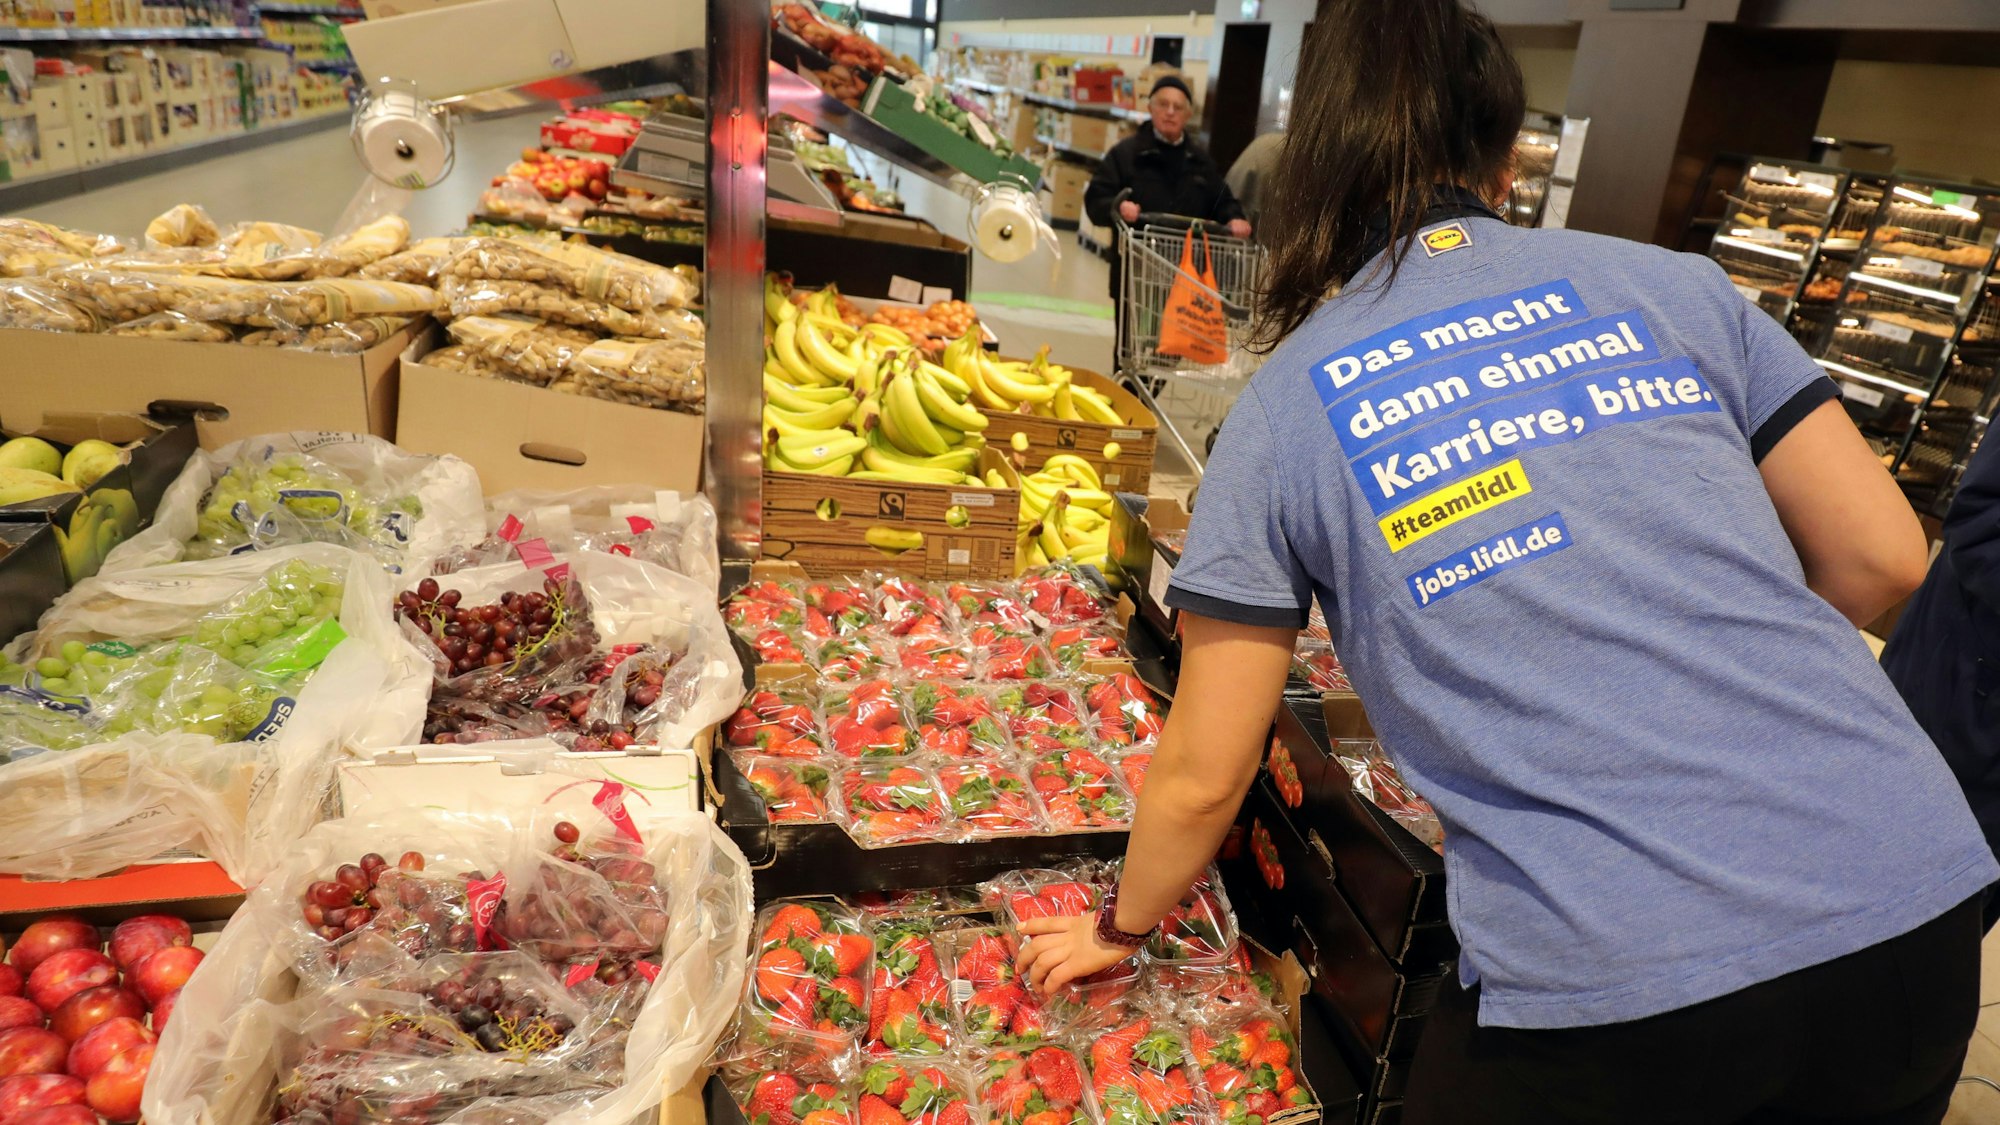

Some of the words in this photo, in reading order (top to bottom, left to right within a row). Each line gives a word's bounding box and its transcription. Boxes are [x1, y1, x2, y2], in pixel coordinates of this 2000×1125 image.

[1324, 336, 1414, 390] Das
[1420, 292, 1572, 352] macht
[1348, 373, 1471, 440] dann
[1478, 321, 1645, 390] einmal
[1371, 409, 1586, 499] Karriere,
[1586, 376, 1714, 416] bitte.
[1391, 471, 1518, 541] #teamlidl
[1415, 526, 1563, 605] jobs.lidl.de
